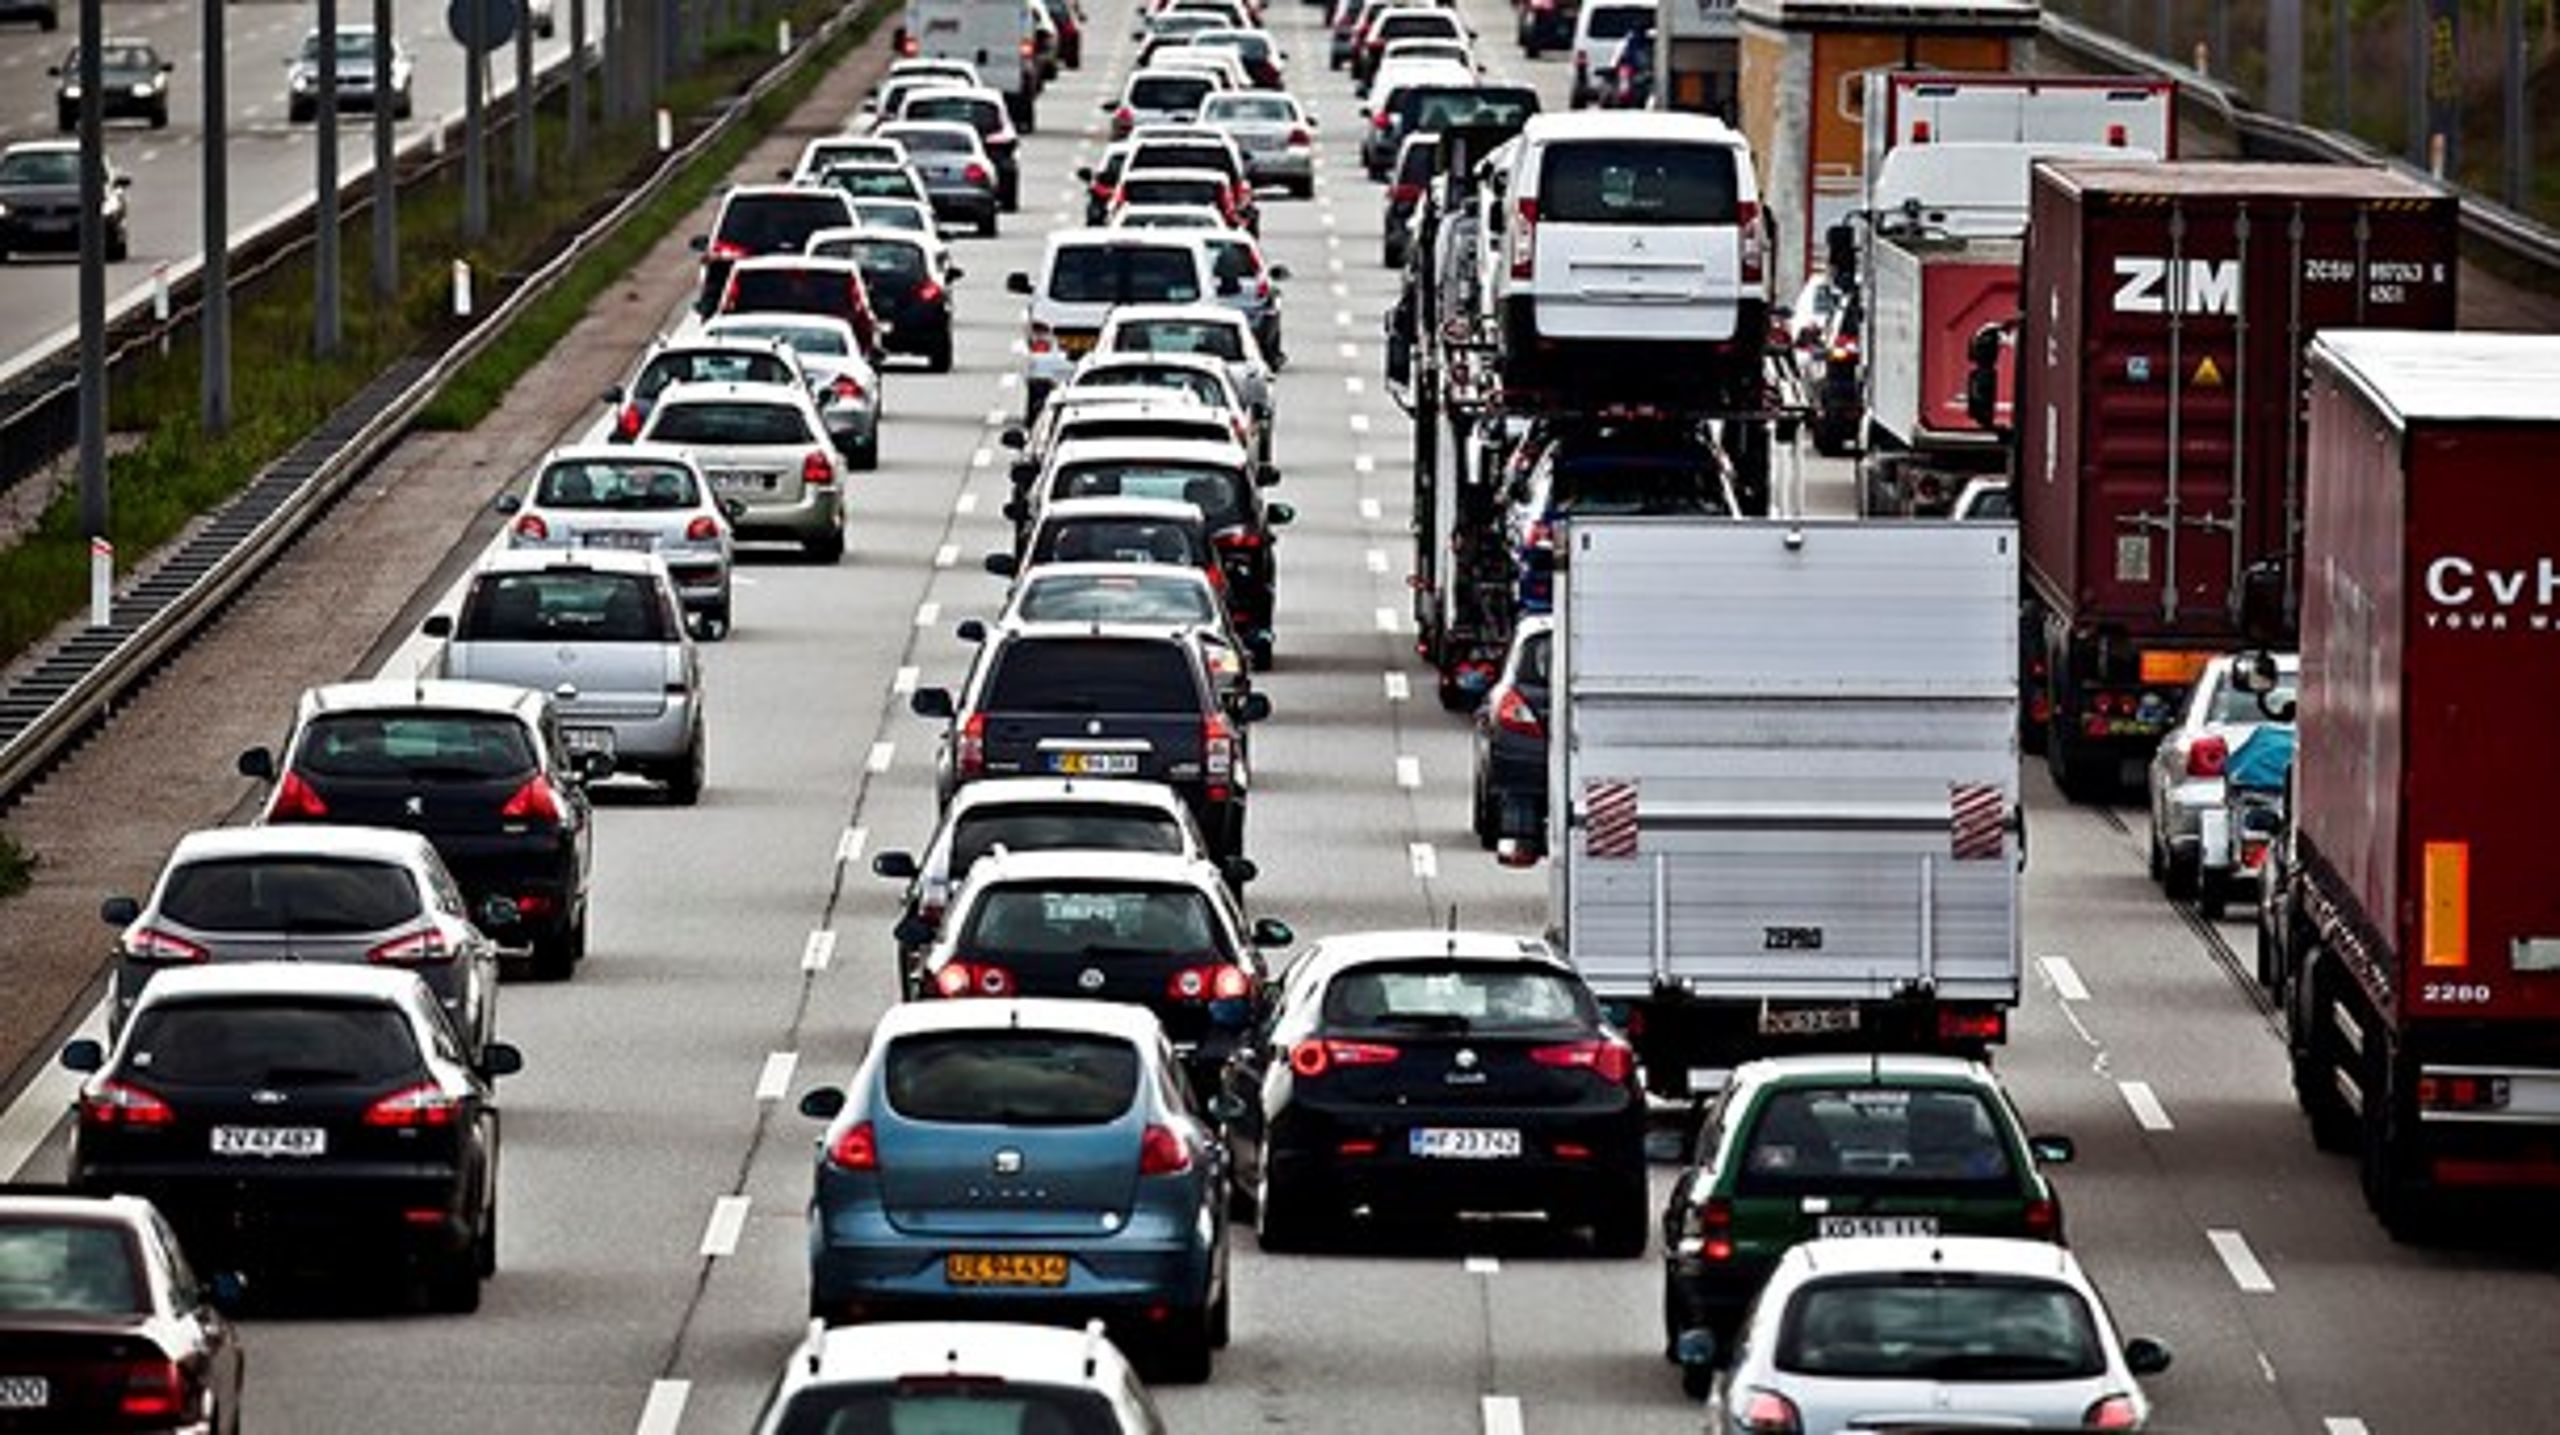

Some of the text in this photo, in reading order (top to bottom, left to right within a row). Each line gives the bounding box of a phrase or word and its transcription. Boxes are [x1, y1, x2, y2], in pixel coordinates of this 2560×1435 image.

[2114, 257, 2240, 314] ZIM
[2426, 612, 2507, 629] YOUR
[1764, 927, 1822, 949] ZEPRO
